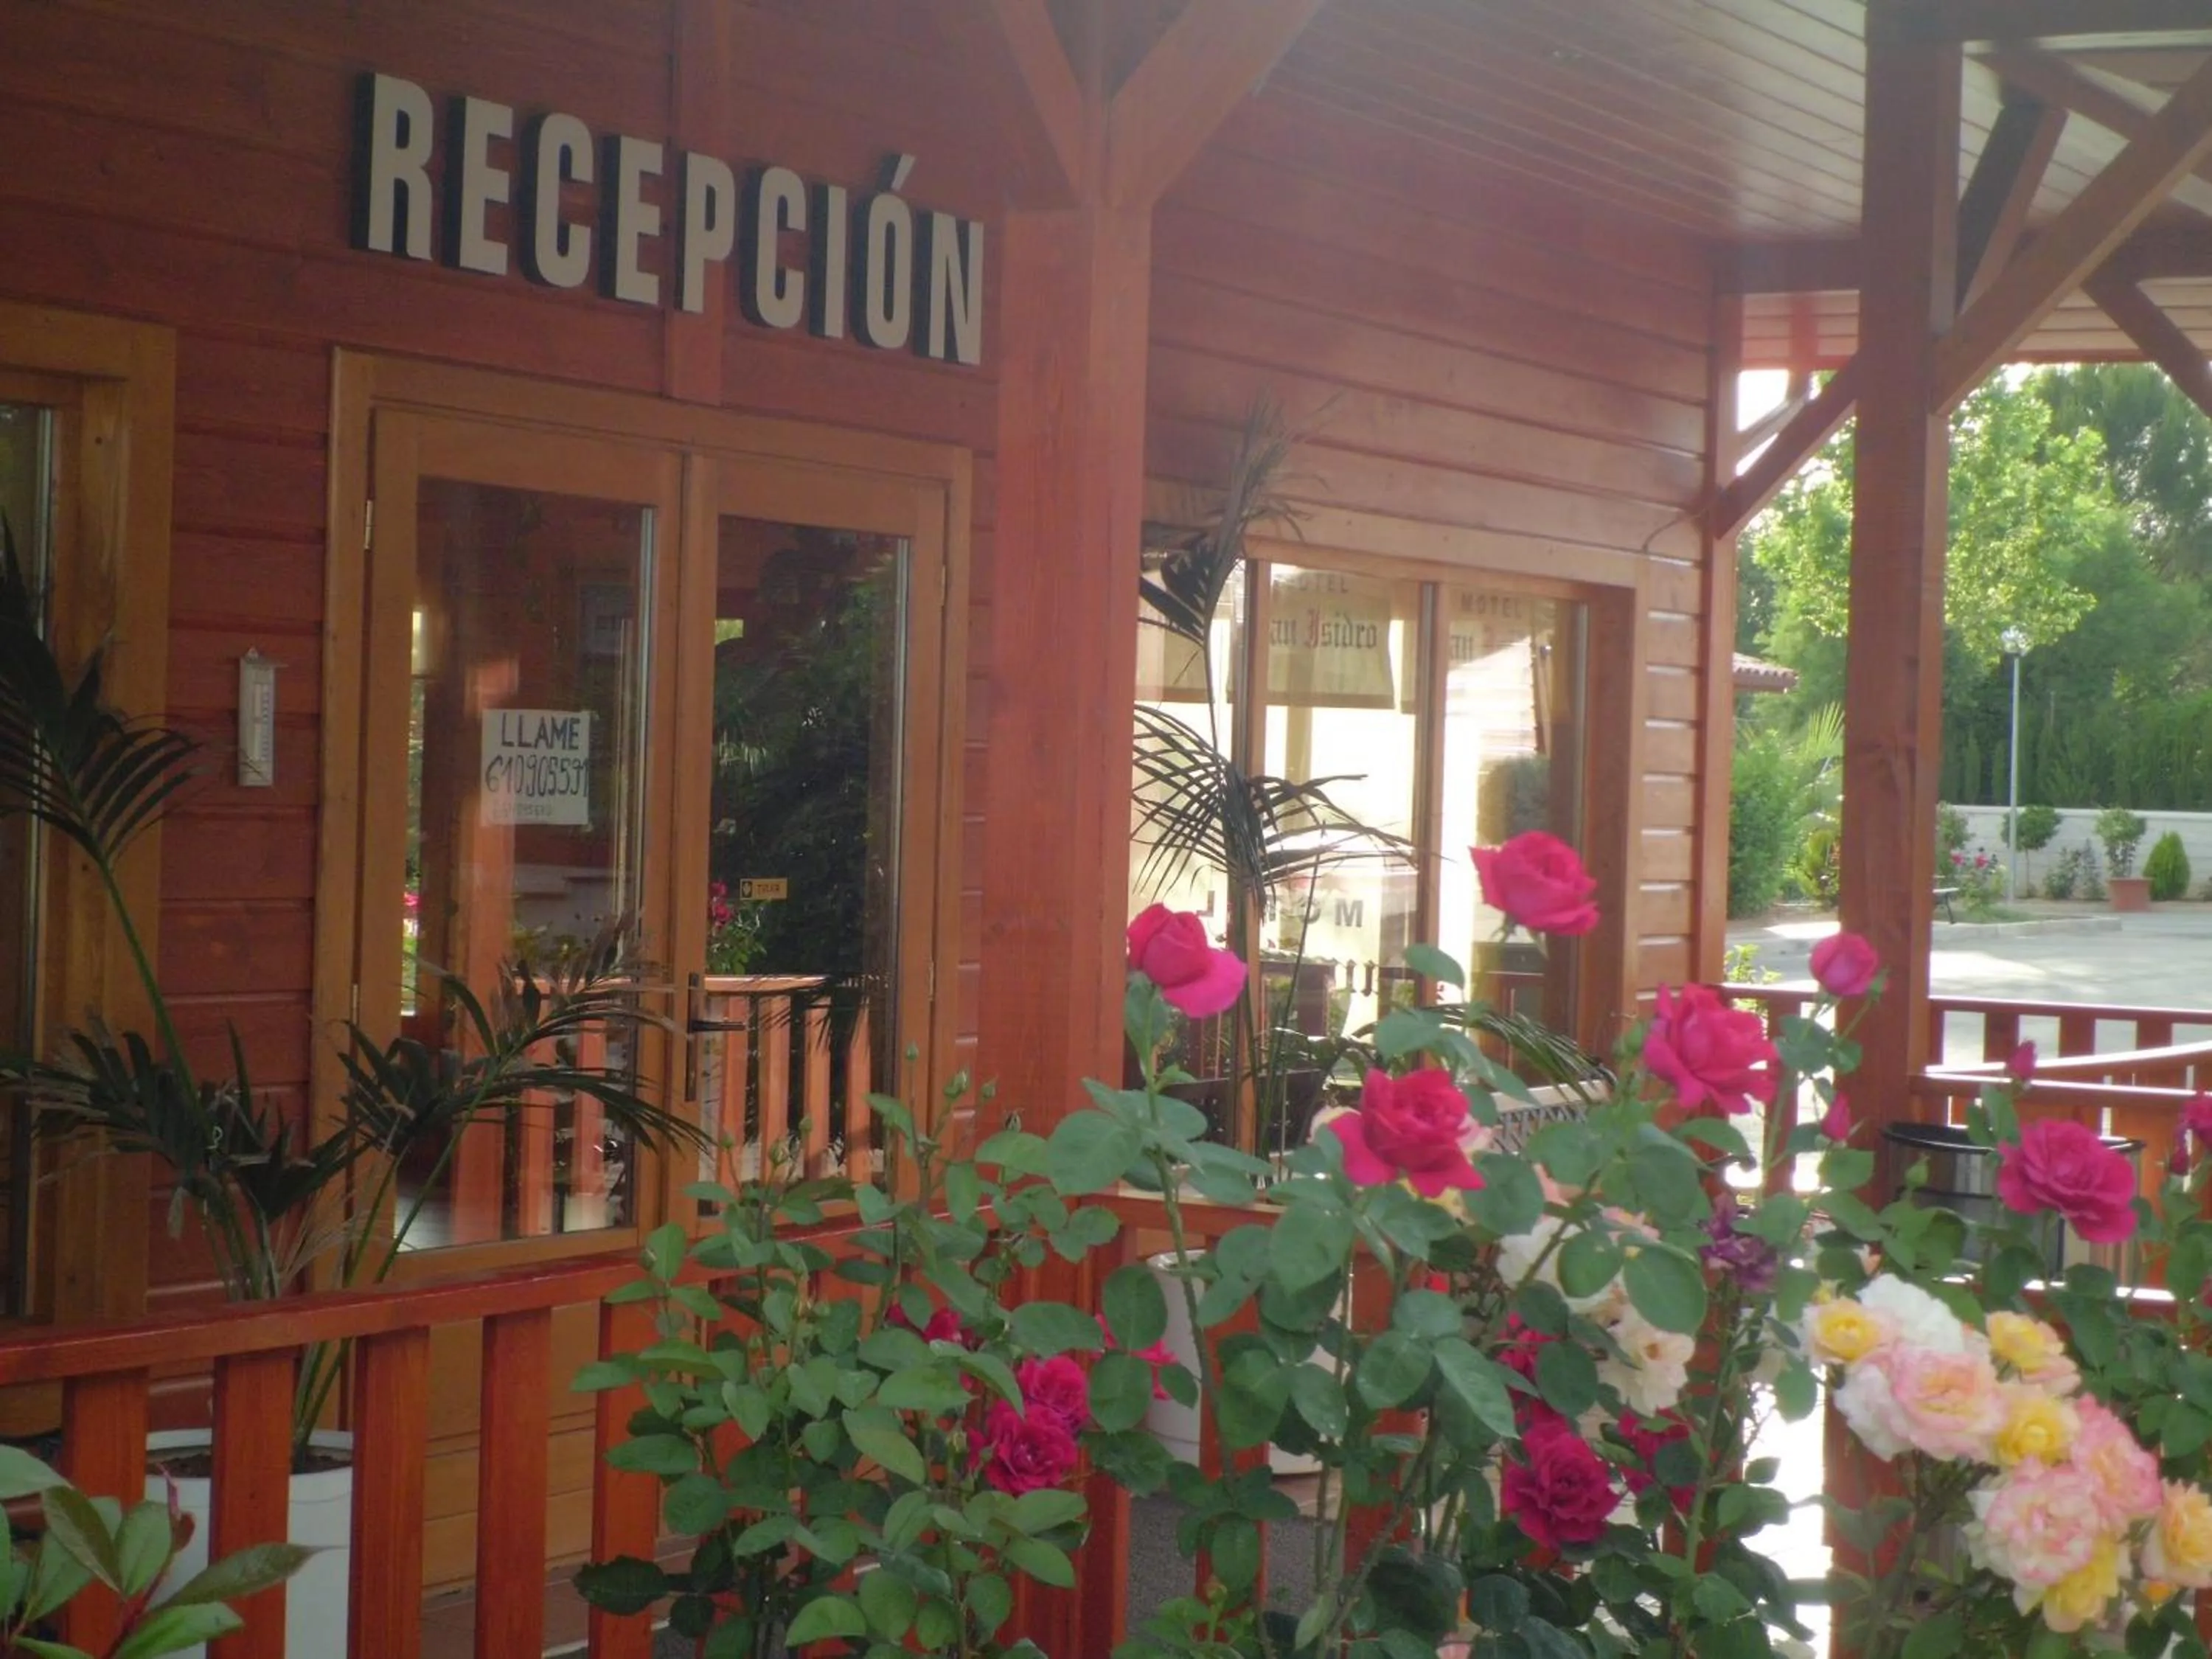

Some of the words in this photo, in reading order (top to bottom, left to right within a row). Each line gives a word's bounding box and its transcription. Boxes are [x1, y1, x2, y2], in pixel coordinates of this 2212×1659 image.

[354, 72, 984, 367] RECEPCIÓN
[1270, 619, 1297, 647] an
[501, 712, 581, 751] LLAME
